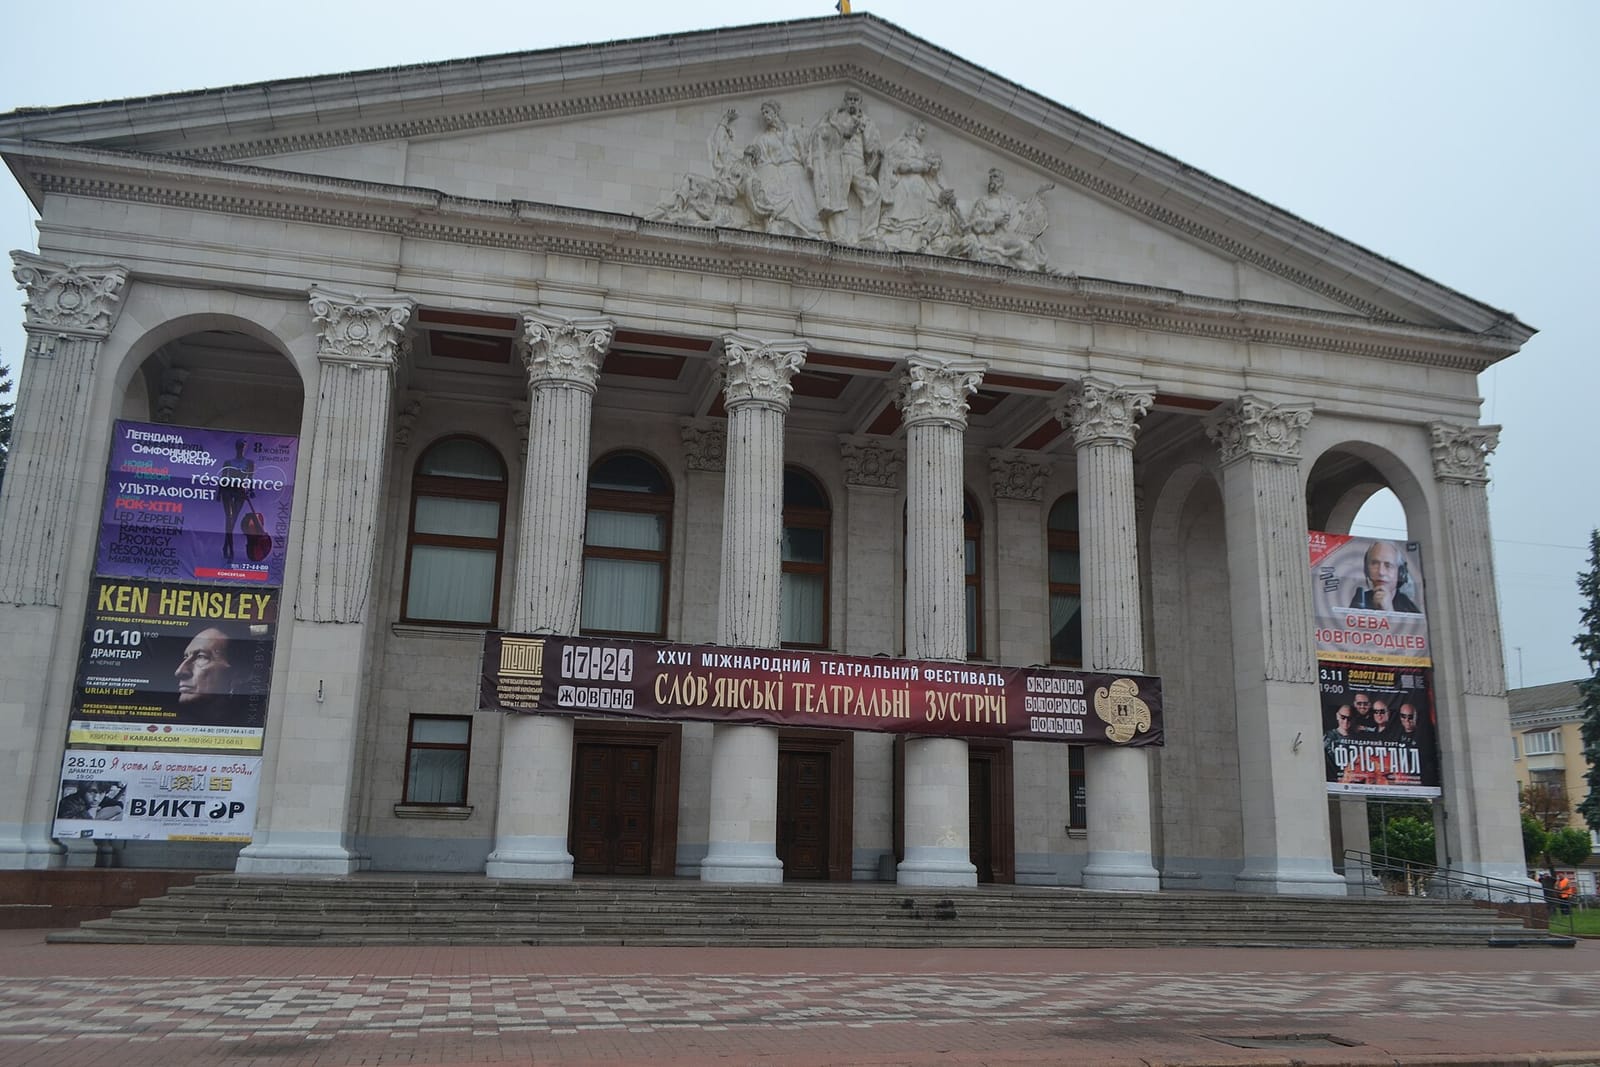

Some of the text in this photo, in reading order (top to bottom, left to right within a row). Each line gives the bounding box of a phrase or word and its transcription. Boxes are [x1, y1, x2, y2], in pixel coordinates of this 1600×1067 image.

[191, 472, 284, 491] résonance
[119, 482, 217, 500] УЛЬТРАФІОЛЕТ
[98, 584, 271, 620] KEN HENSLEY
[1346, 614, 1390, 630] СЕВА
[93, 628, 142, 646] 01.10
[90, 648, 142, 659] ДРАМТЕАТР
[563, 648, 632, 678] 17-24
[656, 650, 1005, 687] XXVI МІЖНАРОДНИЙ ТЕАТРАЛЬНИЙ ФЕСТИВАЛЬ
[1320, 669, 1343, 681] 3.11
[112, 688, 135, 696] HEEP
[1027, 677, 1084, 695] УКРАЇНА
[1320, 683, 1344, 694] 19:00
[559, 688, 633, 707] ЖОВТНЯ
[792, 681, 910, 719] ТЕАТРАЛЬНІ
[925, 687, 1007, 724] ЗУСТРІЧІ
[1025, 696, 1087, 715] БІЛОРУСЬ
[129, 735, 180, 743] KARABAS.COM
[67, 757, 106, 768] 28.10
[109, 757, 120, 769] Я
[1334, 743, 1421, 774] ФРІСТАЙЛ
